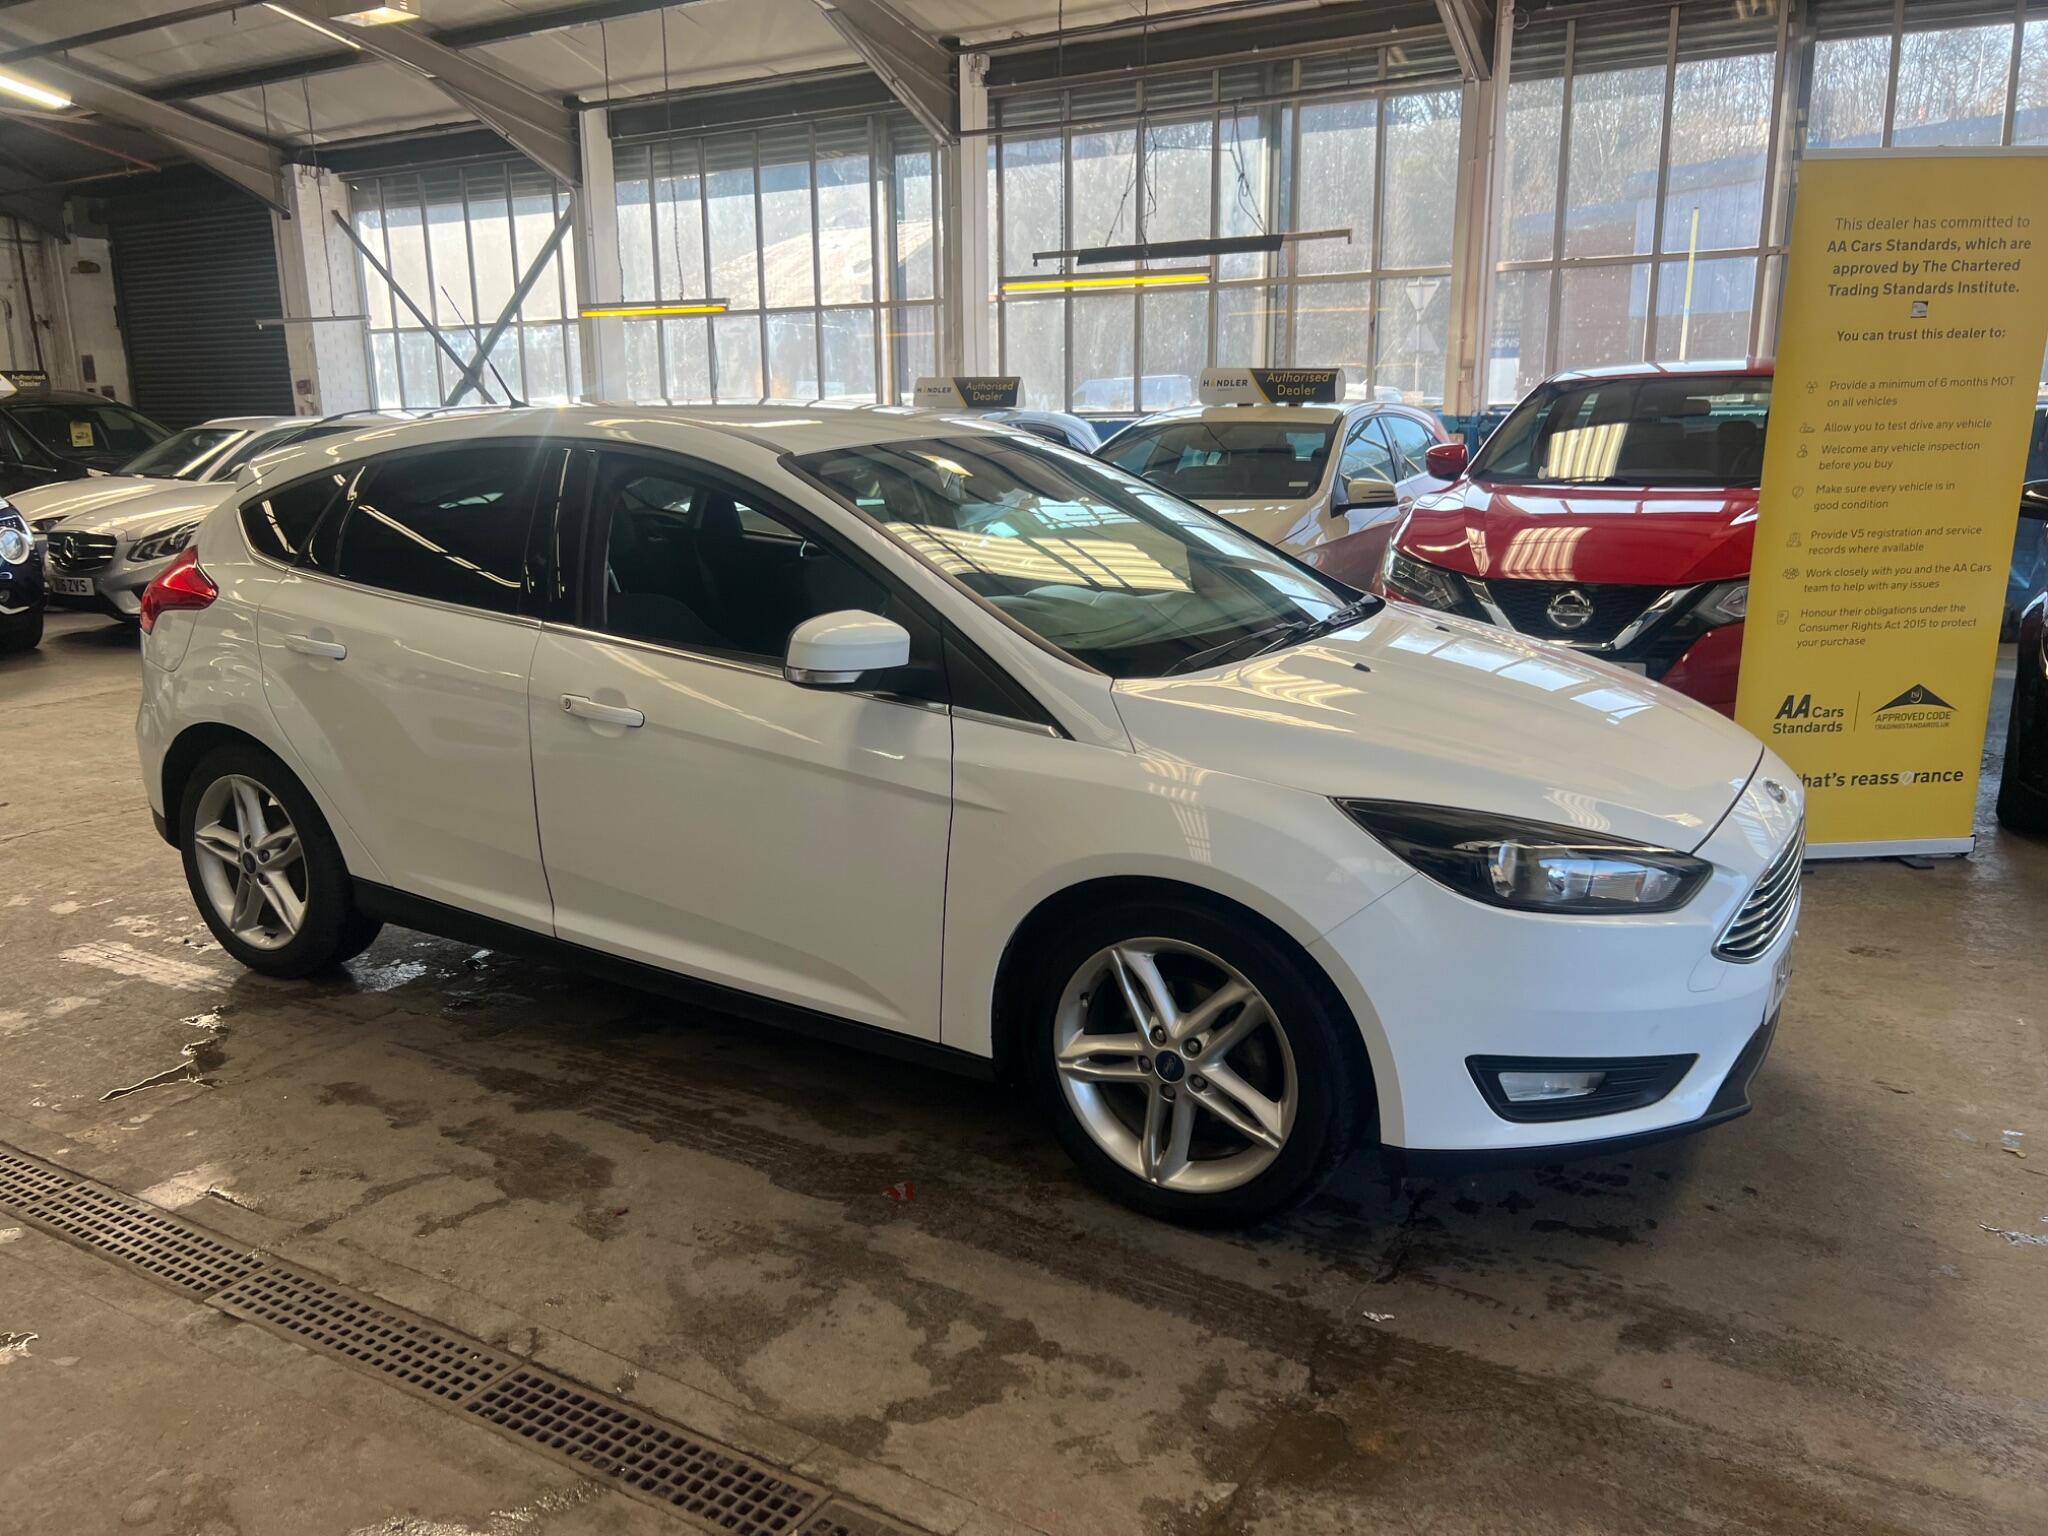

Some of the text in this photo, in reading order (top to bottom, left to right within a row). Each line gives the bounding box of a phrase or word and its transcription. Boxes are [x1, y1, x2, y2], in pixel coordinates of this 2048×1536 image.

[1835, 215, 2031, 232] This dealer has committed to
[1826, 236, 2032, 253] AA Cars Standards, which are
[1832, 258, 2021, 277] approved by The Chartered
[1827, 280, 2020, 299] Trading Standards Institute.
[1837, 327, 2006, 342] You can trust this dealer to:
[1266, 372, 1331, 383] Authorised
[1829, 375, 2015, 393] Provide a minimum of 6 months MOT
[965, 381, 1014, 391] Authorised
[1277, 384, 1316, 396] Dealer
[973, 391, 1003, 401] Dealer
[1826, 395, 1898, 409] on all vehicles
[1823, 418, 1993, 434] Allow you to test drive any vehicle
[1821, 440, 1981, 455] Welcome any vehicle inspection
[1818, 458, 1894, 472] before you buy
[1815, 481, 1956, 495] Make sure every vehicle is in
[1813, 498, 1889, 513] good condition
[1810, 525, 1983, 540] Provide V5 registration and service
[1808, 542, 1925, 556] records where available
[1805, 562, 1992, 578] Work closely with you and the AA Cars
[1803, 580, 1940, 593] team to help with any issues
[1800, 603, 1967, 618] Honour their obligations under the
[1798, 617, 1977, 633] Consumer Rights Act 2015 to protect
[1796, 636, 1866, 649] your purchase
[1775, 694, 1844, 719] AA Cars
[1875, 710, 1952, 722] APPROVED CODE
[1772, 721, 1843, 735] Standards
[1796, 772, 1845, 788] hat's
